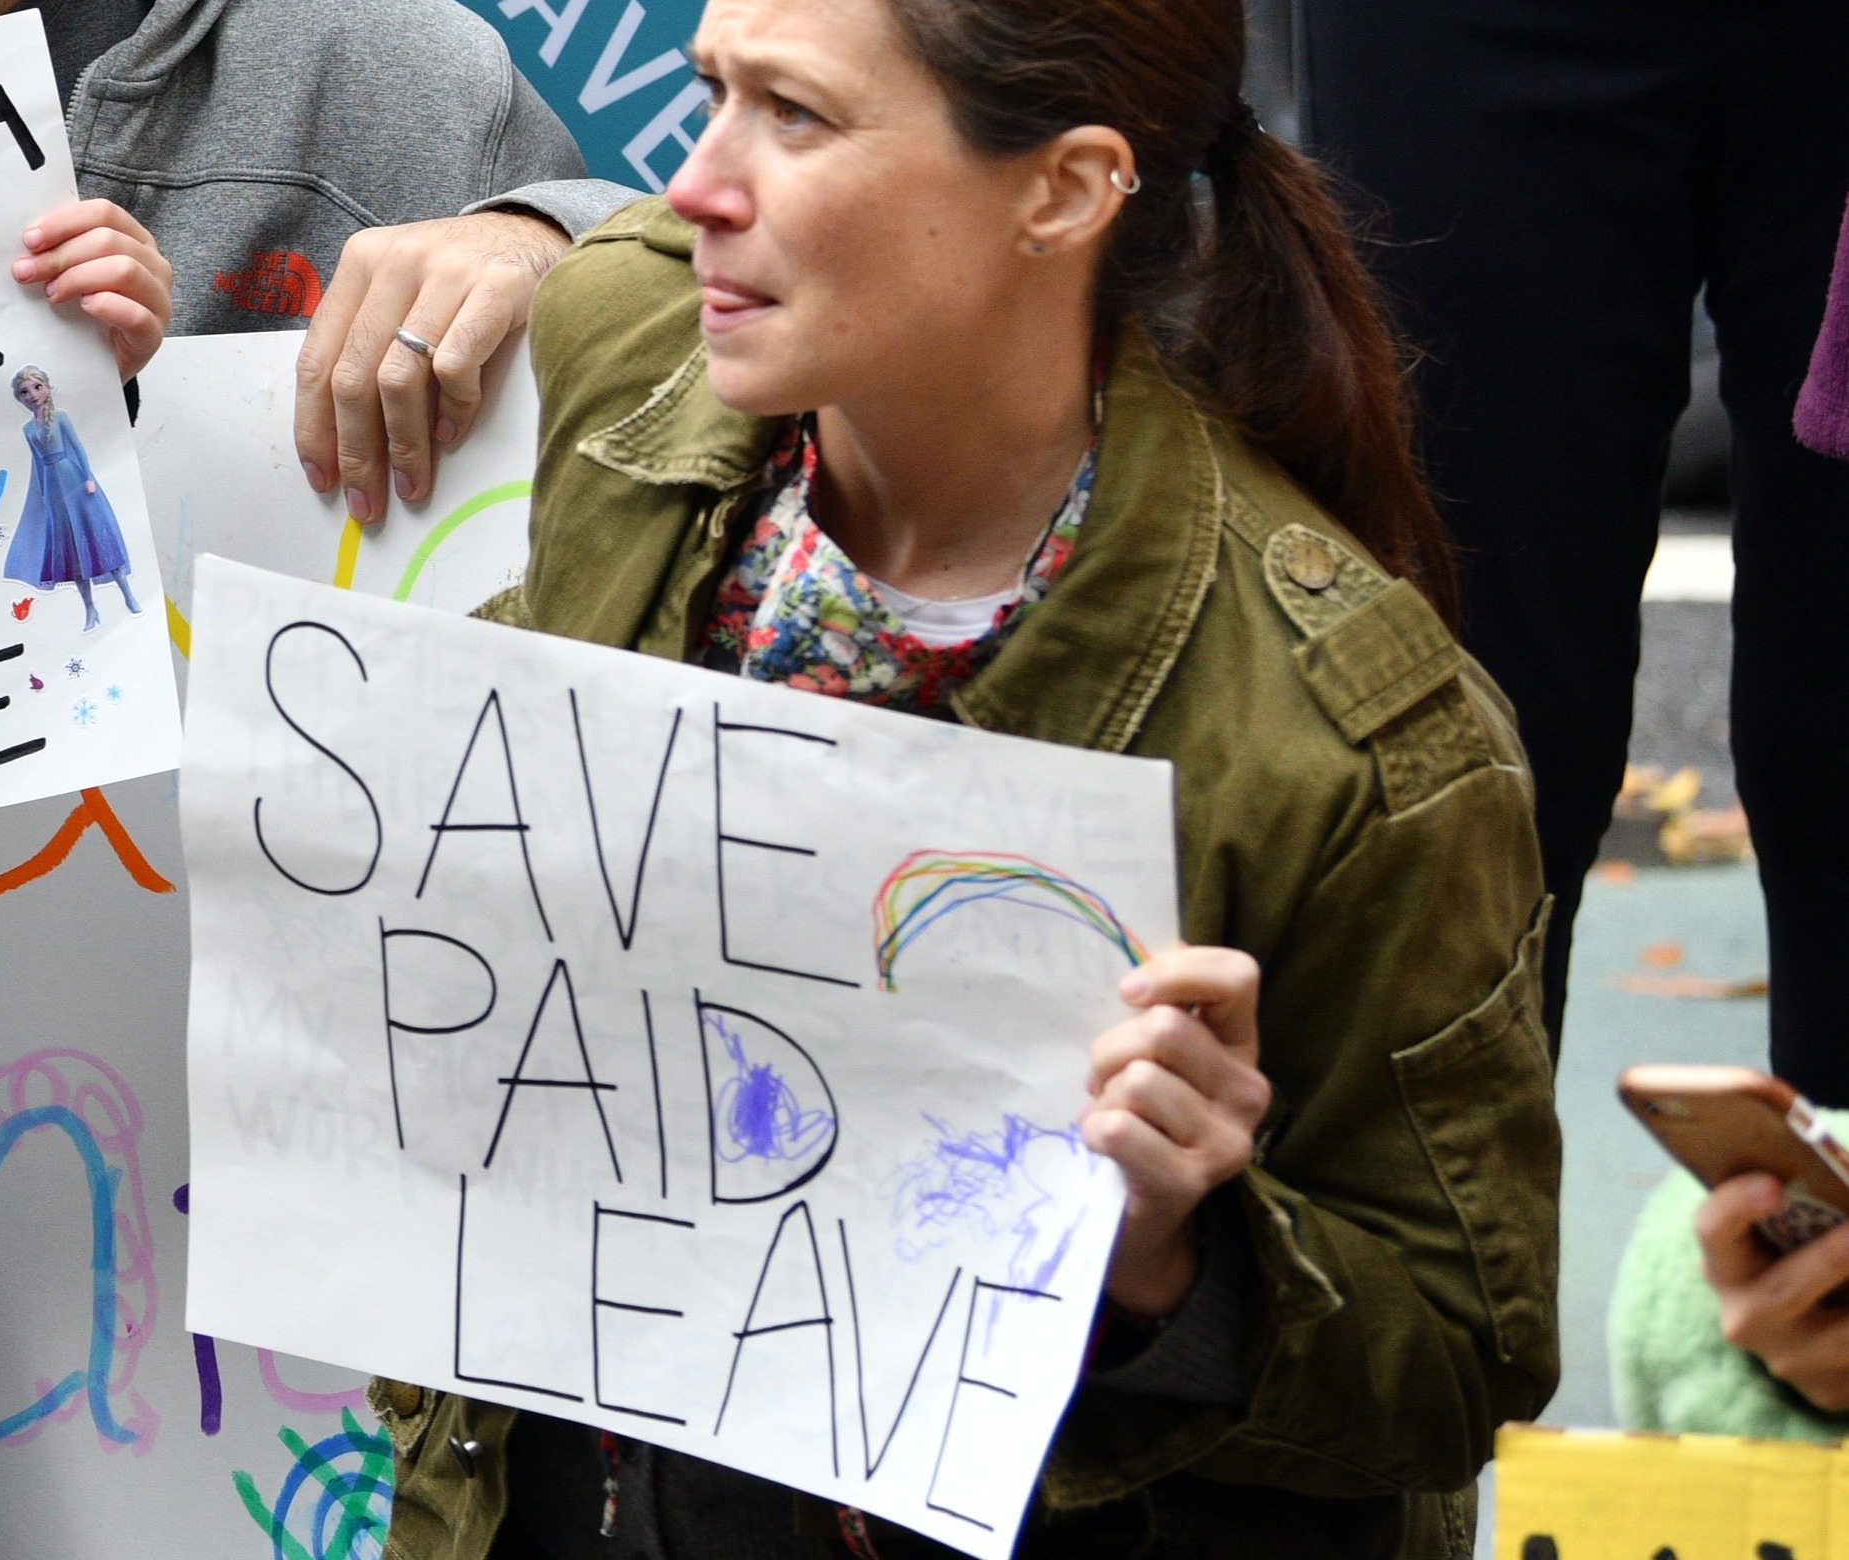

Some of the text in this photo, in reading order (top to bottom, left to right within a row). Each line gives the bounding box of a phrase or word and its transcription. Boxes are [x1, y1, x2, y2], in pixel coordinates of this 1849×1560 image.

[254, 620, 862, 989] SAVE
[379, 914, 839, 1207] PAID
[454, 1173, 1063, 1532] LEAVE
